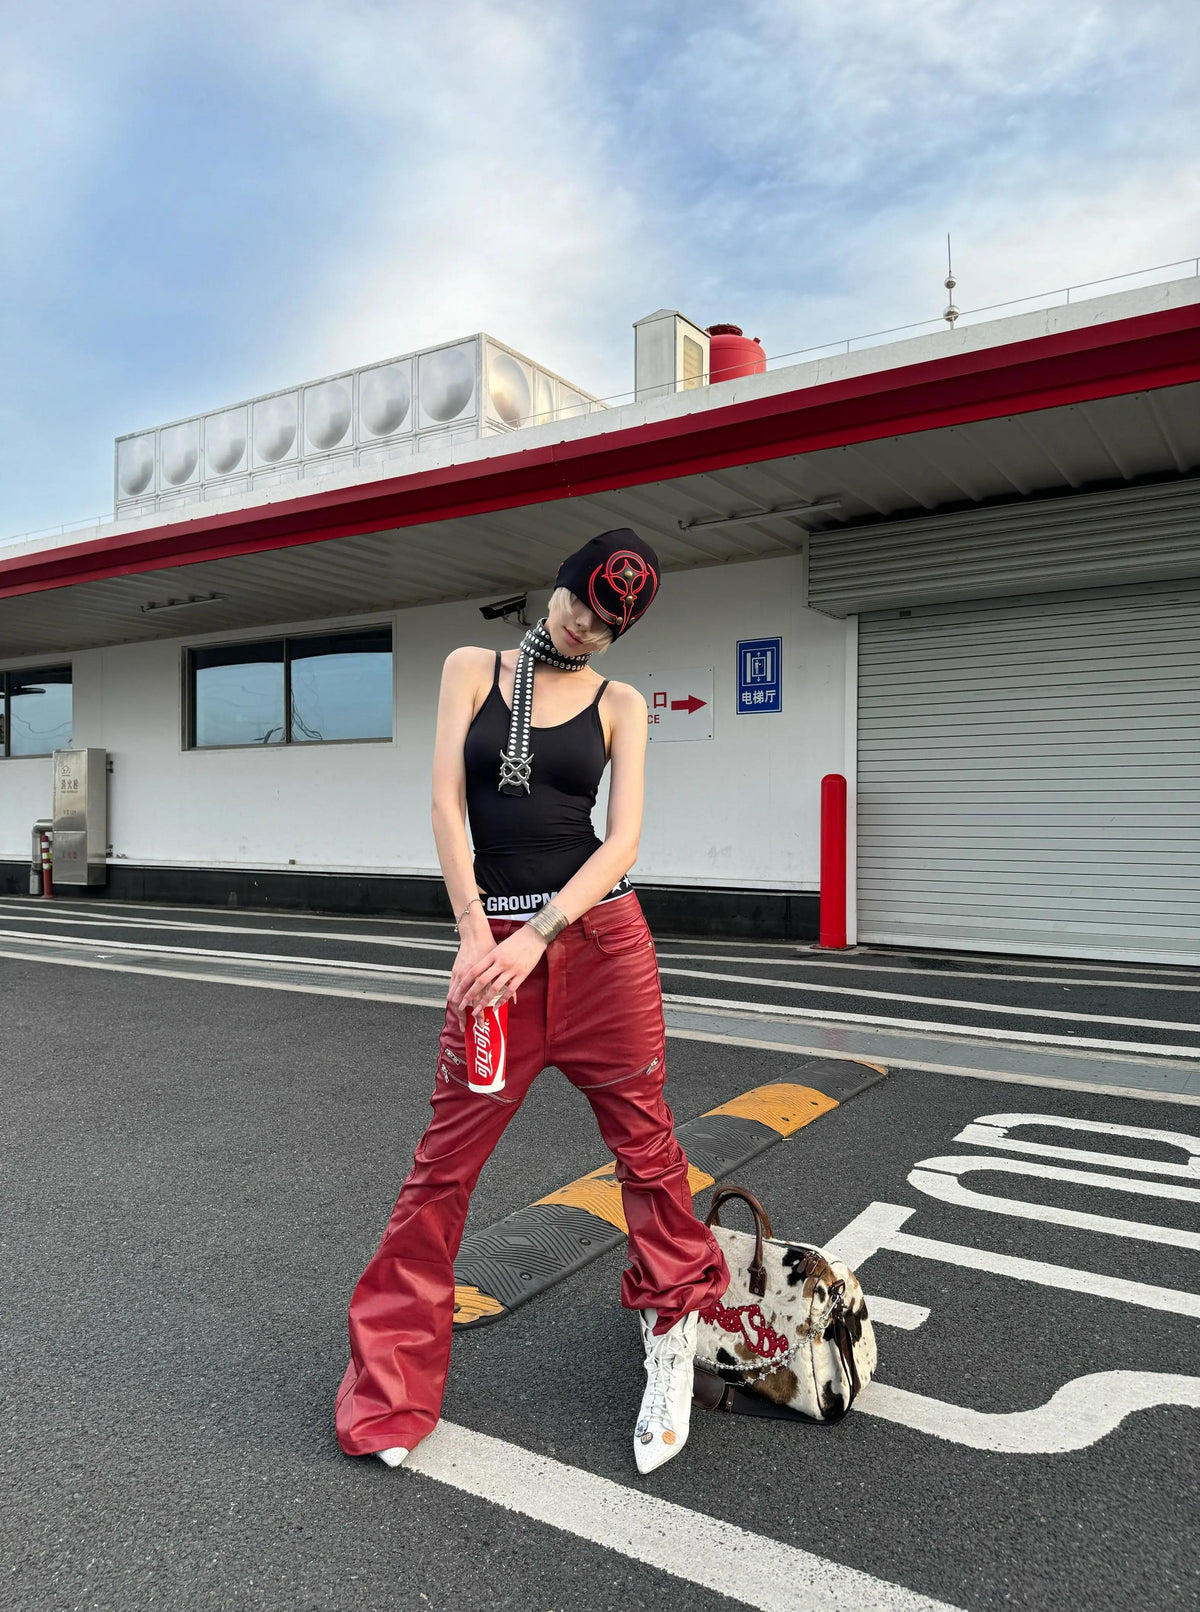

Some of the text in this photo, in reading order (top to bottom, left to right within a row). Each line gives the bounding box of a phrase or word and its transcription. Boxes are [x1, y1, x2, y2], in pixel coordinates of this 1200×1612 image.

[647, 691, 667, 709] 口
[741, 689, 777, 706] 电梯厅
